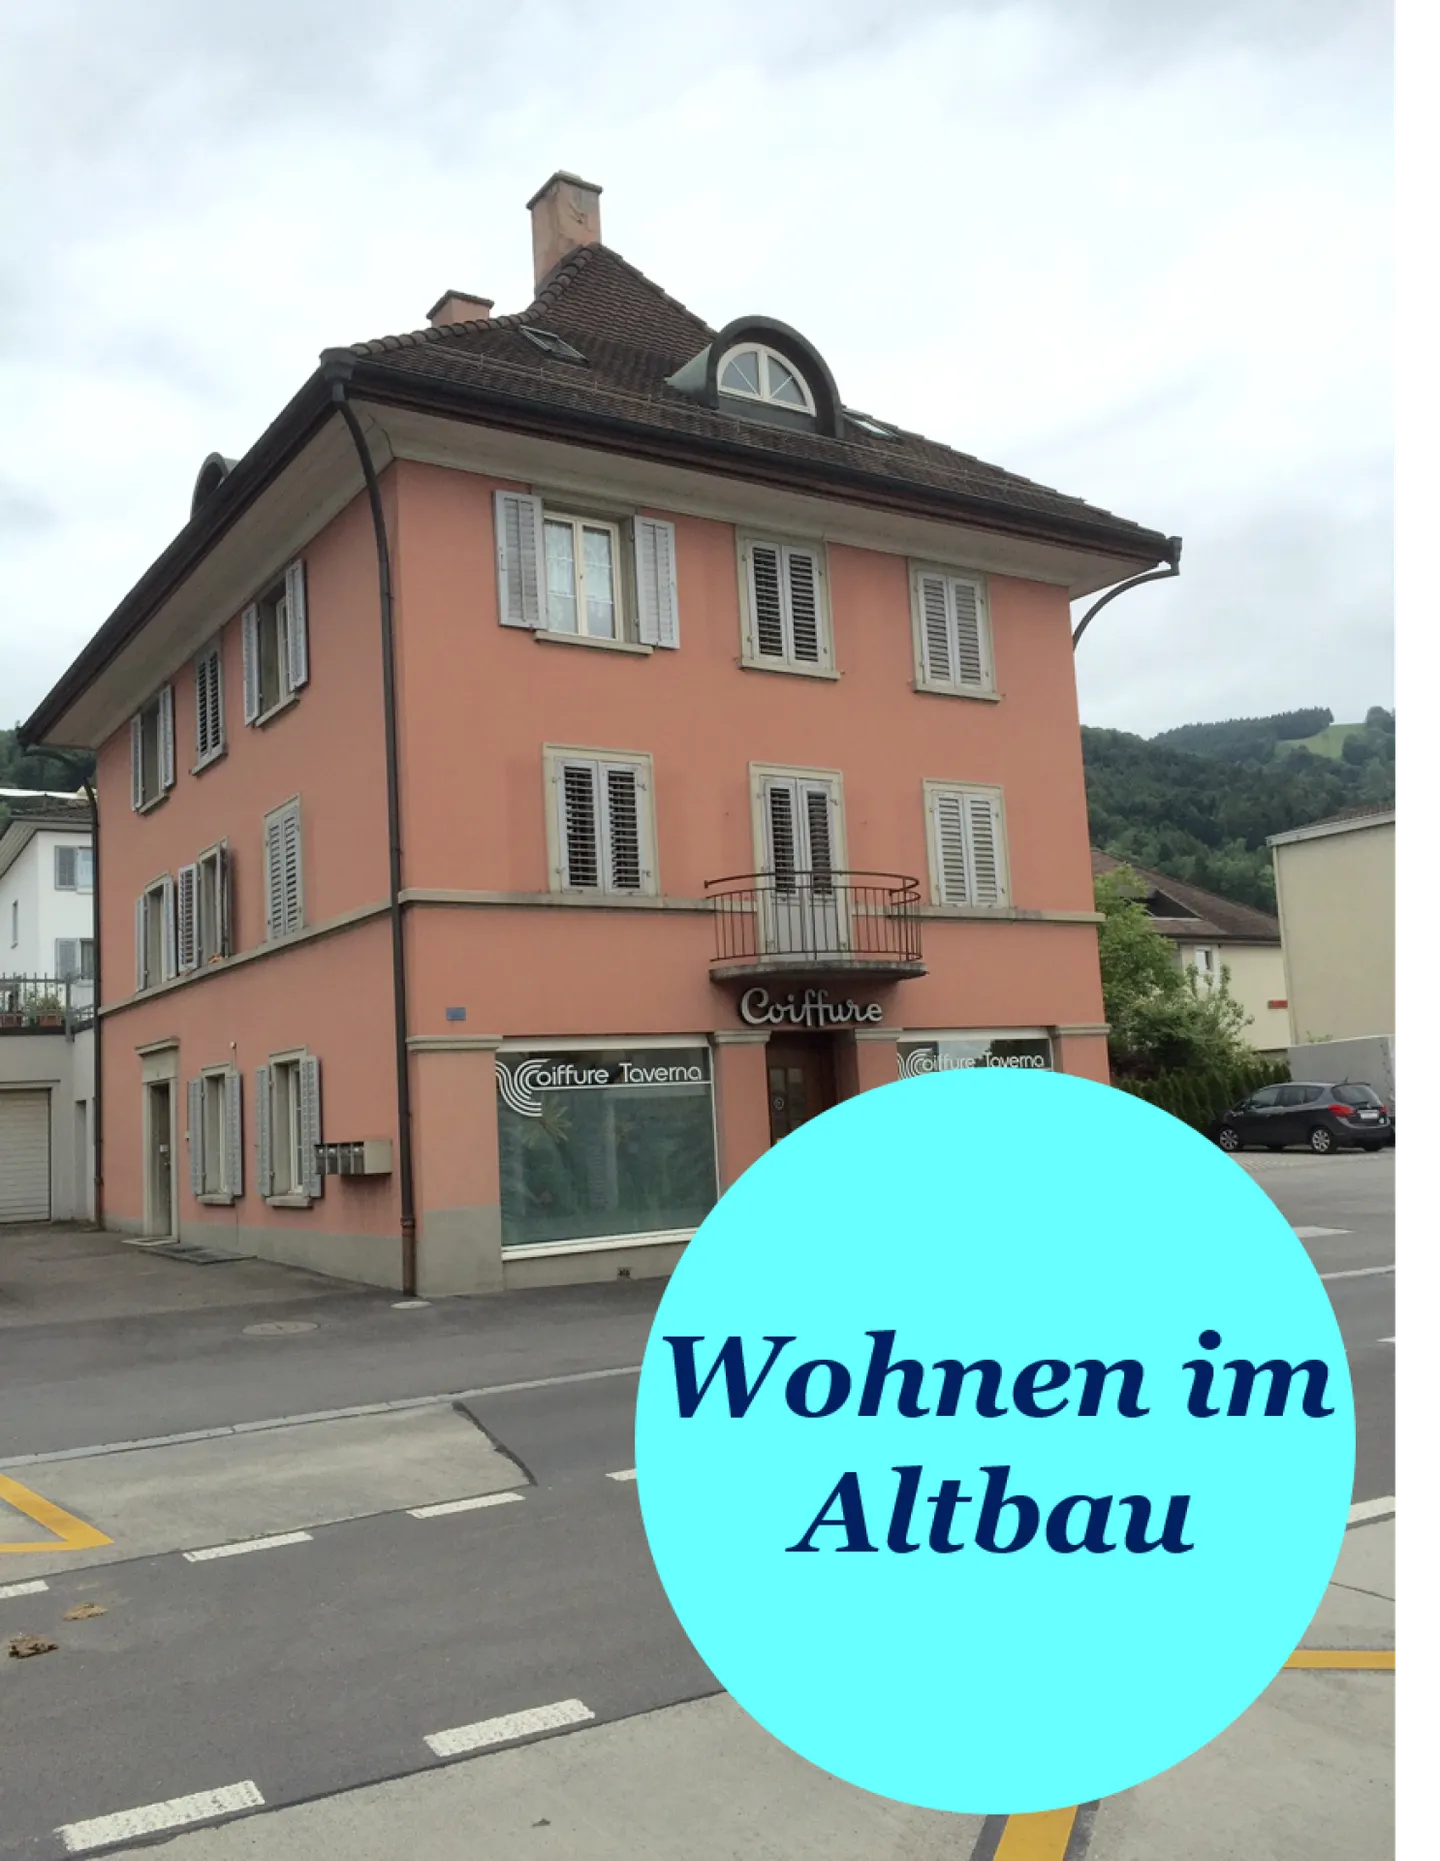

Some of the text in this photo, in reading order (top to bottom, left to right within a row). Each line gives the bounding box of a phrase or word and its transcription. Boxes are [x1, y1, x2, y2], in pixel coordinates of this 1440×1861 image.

[741, 987, 883, 1027] Coiffure
[513, 1058, 702, 1098] Coiffure Taverna
[982, 1051, 1045, 1069] Taverna
